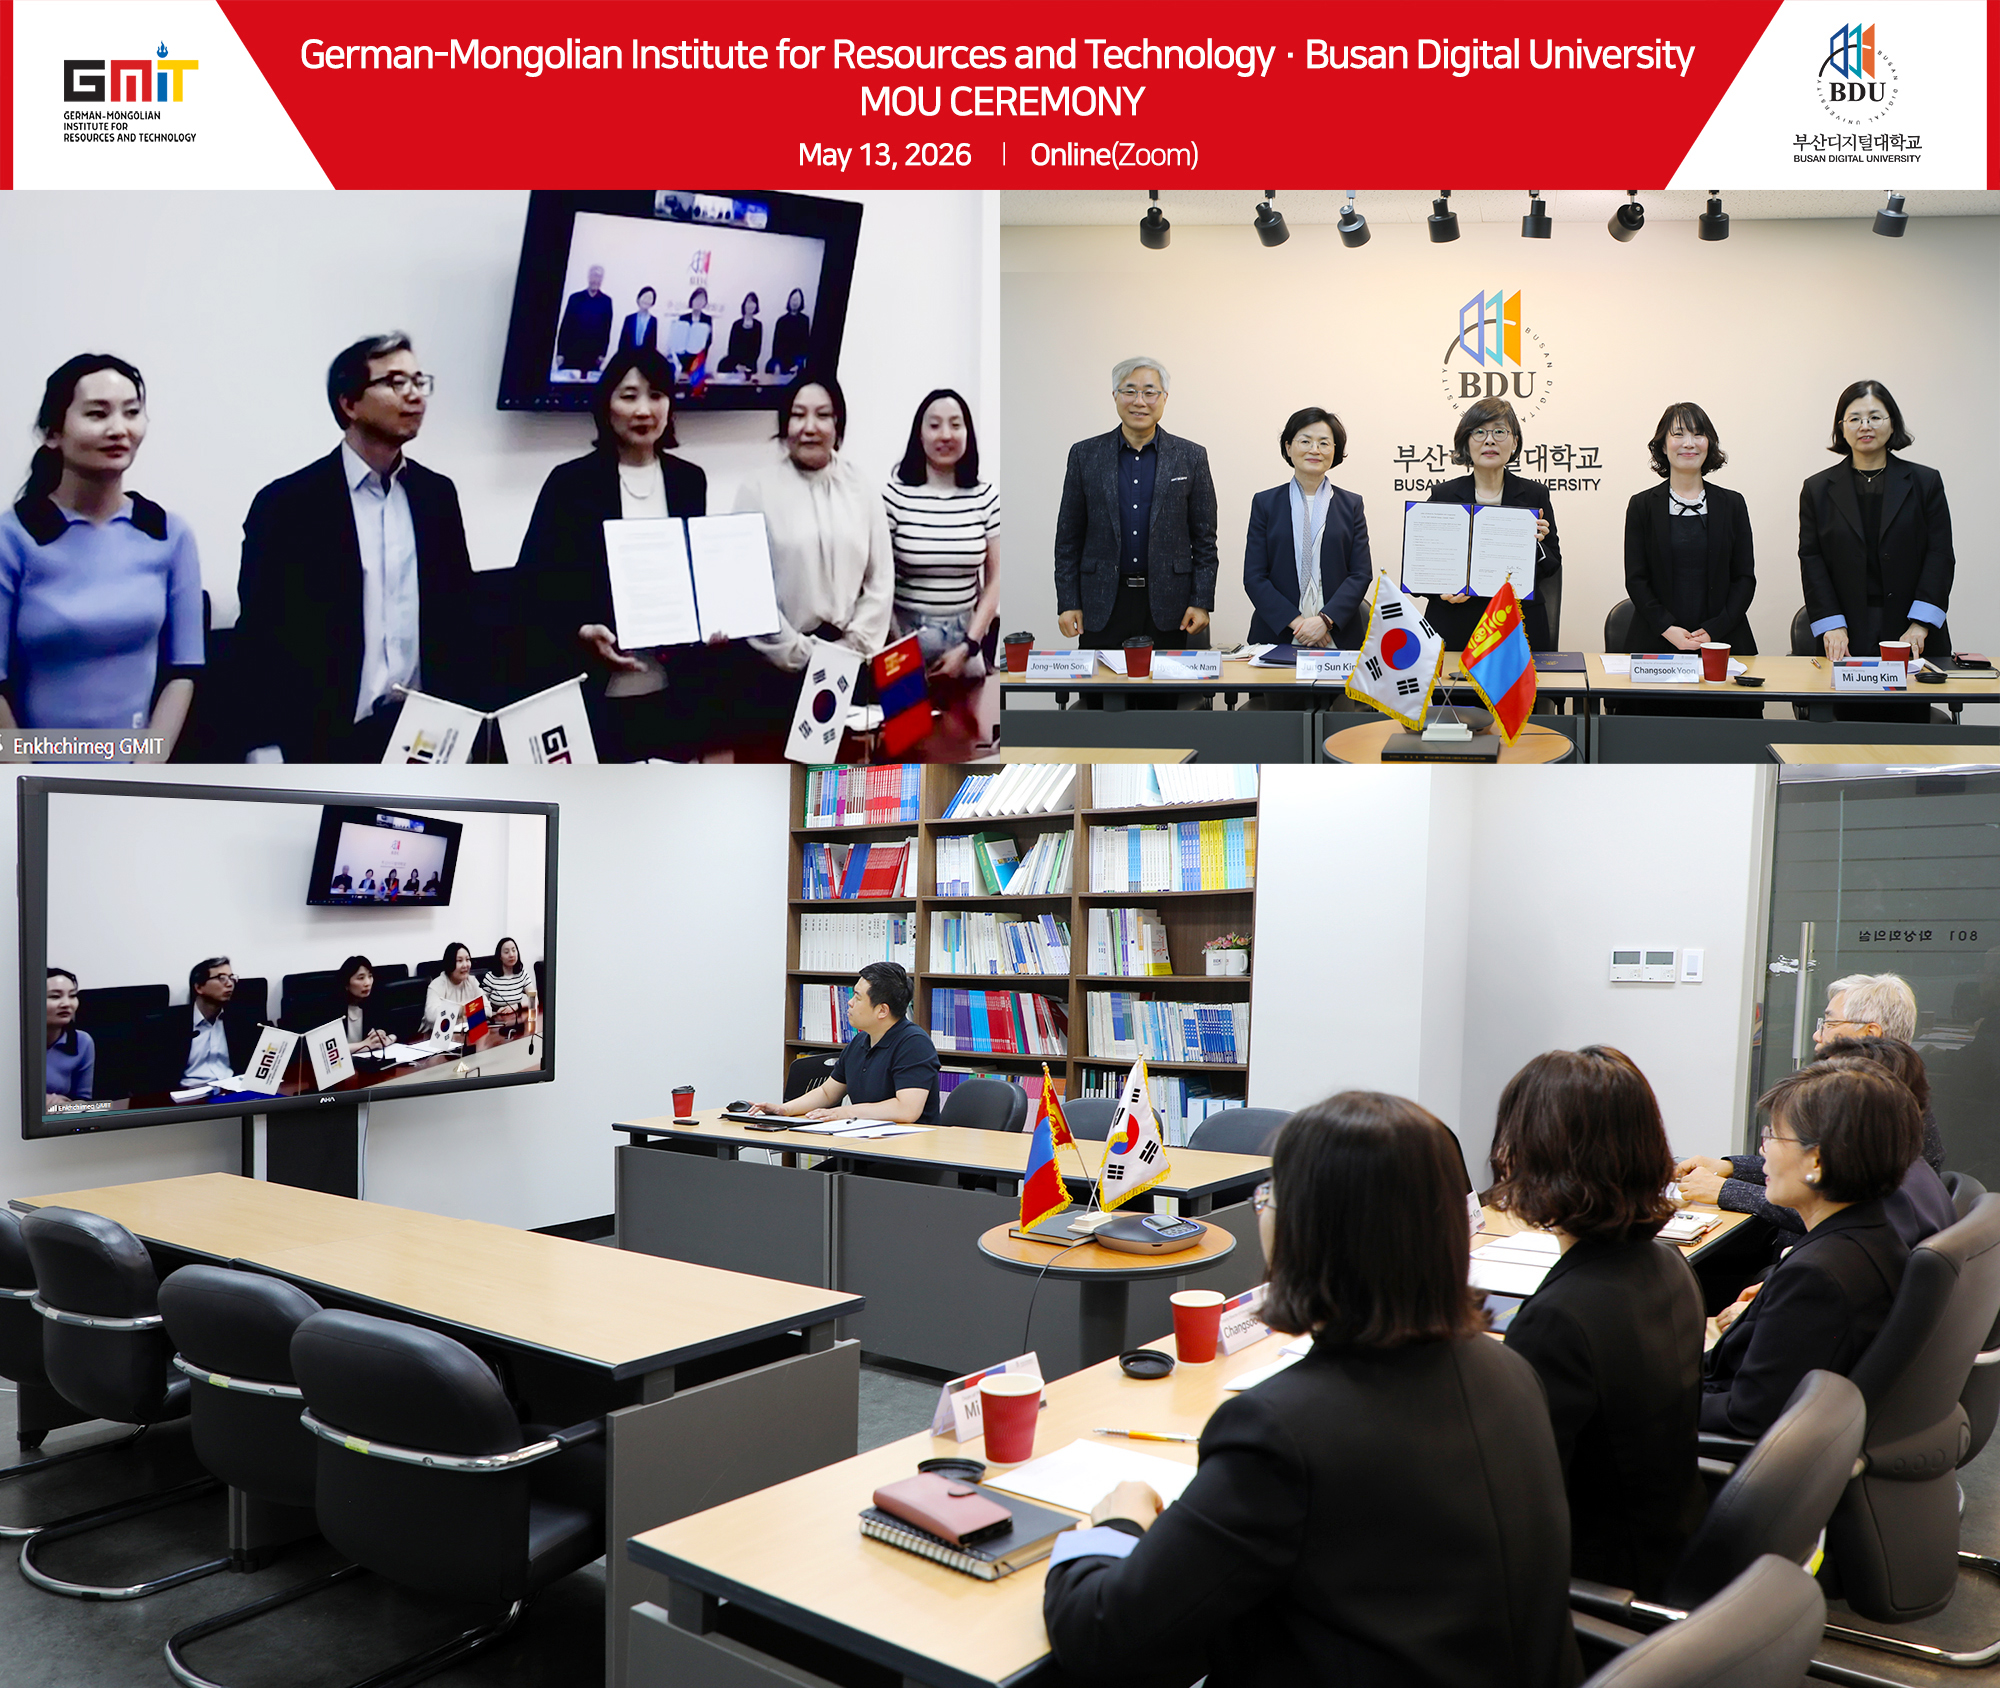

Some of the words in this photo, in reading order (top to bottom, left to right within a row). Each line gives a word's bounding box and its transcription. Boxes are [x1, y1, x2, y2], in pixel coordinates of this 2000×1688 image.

[1458, 371, 1537, 399] BDU
[1521, 380, 1553, 423] DIGITA
[1030, 663, 1069, 672] Jong-Won
[1070, 662, 1089, 672] Song
[1199, 663, 1217, 671] Nam
[1302, 662, 1322, 673] Jung
[1324, 662, 1341, 671] Sun
[1634, 666, 1676, 675] Changsook
[1842, 673, 1854, 682] Mi
[1855, 673, 1878, 684] Jung
[1880, 673, 1899, 682] Kim
[13, 736, 116, 760] Enkhchimeg
[119, 737, 165, 755] GMIT
[1223, 1315, 1260, 1339] Changsoo
[964, 1399, 981, 1420] Mi
